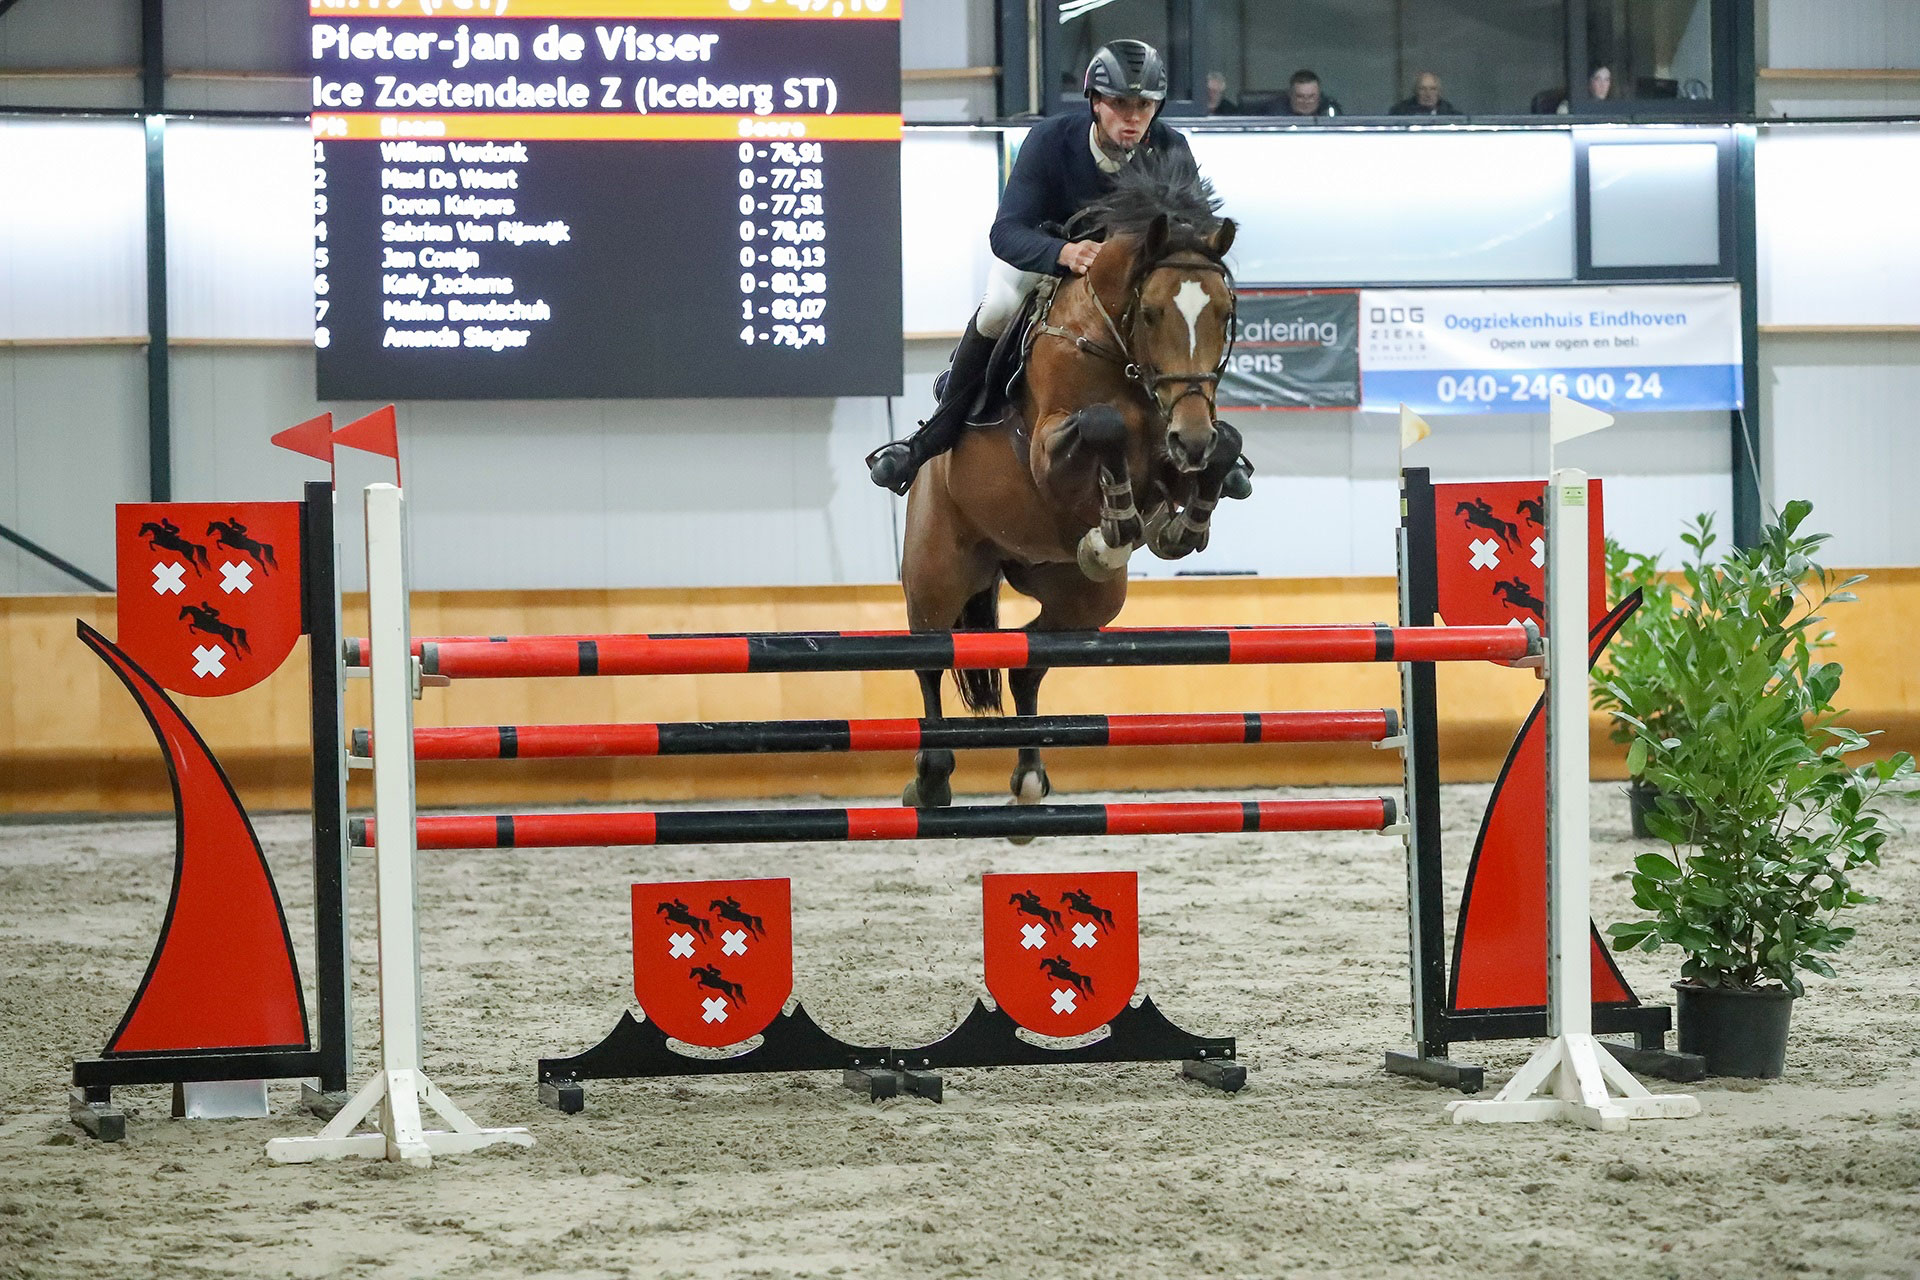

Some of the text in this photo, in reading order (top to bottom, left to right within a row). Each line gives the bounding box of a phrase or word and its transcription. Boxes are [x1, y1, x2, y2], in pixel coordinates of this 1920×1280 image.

[312, 24, 719, 68] Pieter-jan de Visser
[313, 76, 837, 115] Ice Zoetendaele Z (Iceberg ST)
[314, 142, 325, 162] 1
[449, 142, 528, 162] Verdonk
[739, 143, 753, 162] 0
[771, 143, 823, 166] 76,91
[314, 169, 327, 188] 2
[430, 169, 456, 188] De
[740, 169, 754, 188] 0
[771, 169, 823, 192] 77,51
[314, 195, 327, 214] 3
[383, 195, 440, 215] Doron
[445, 195, 515, 219] Kuipers
[740, 195, 754, 214] 0
[772, 195, 823, 218] 77,51
[313, 221, 327, 241] 4
[382, 221, 452, 241] Sabrina
[456, 222, 493, 241] Van
[740, 221, 754, 240] 0
[315, 248, 328, 267] 5
[382, 248, 415, 267] Jan
[740, 247, 755, 266] 0
[314, 274, 329, 294] 6
[741, 273, 755, 293] 0
[315, 301, 329, 320] 7
[743, 300, 753, 319] 1
[1445, 310, 1687, 333] Oogziekenhuis Eindhoven
[383, 326, 459, 347] Amanda
[741, 326, 754, 344] 4
[1490, 338, 1526, 351] Open
[1530, 340, 1551, 349] uw
[1555, 338, 1589, 350] ogen
[1593, 338, 1610, 348] en
[1437, 372, 1663, 402] 040-246 00 24
